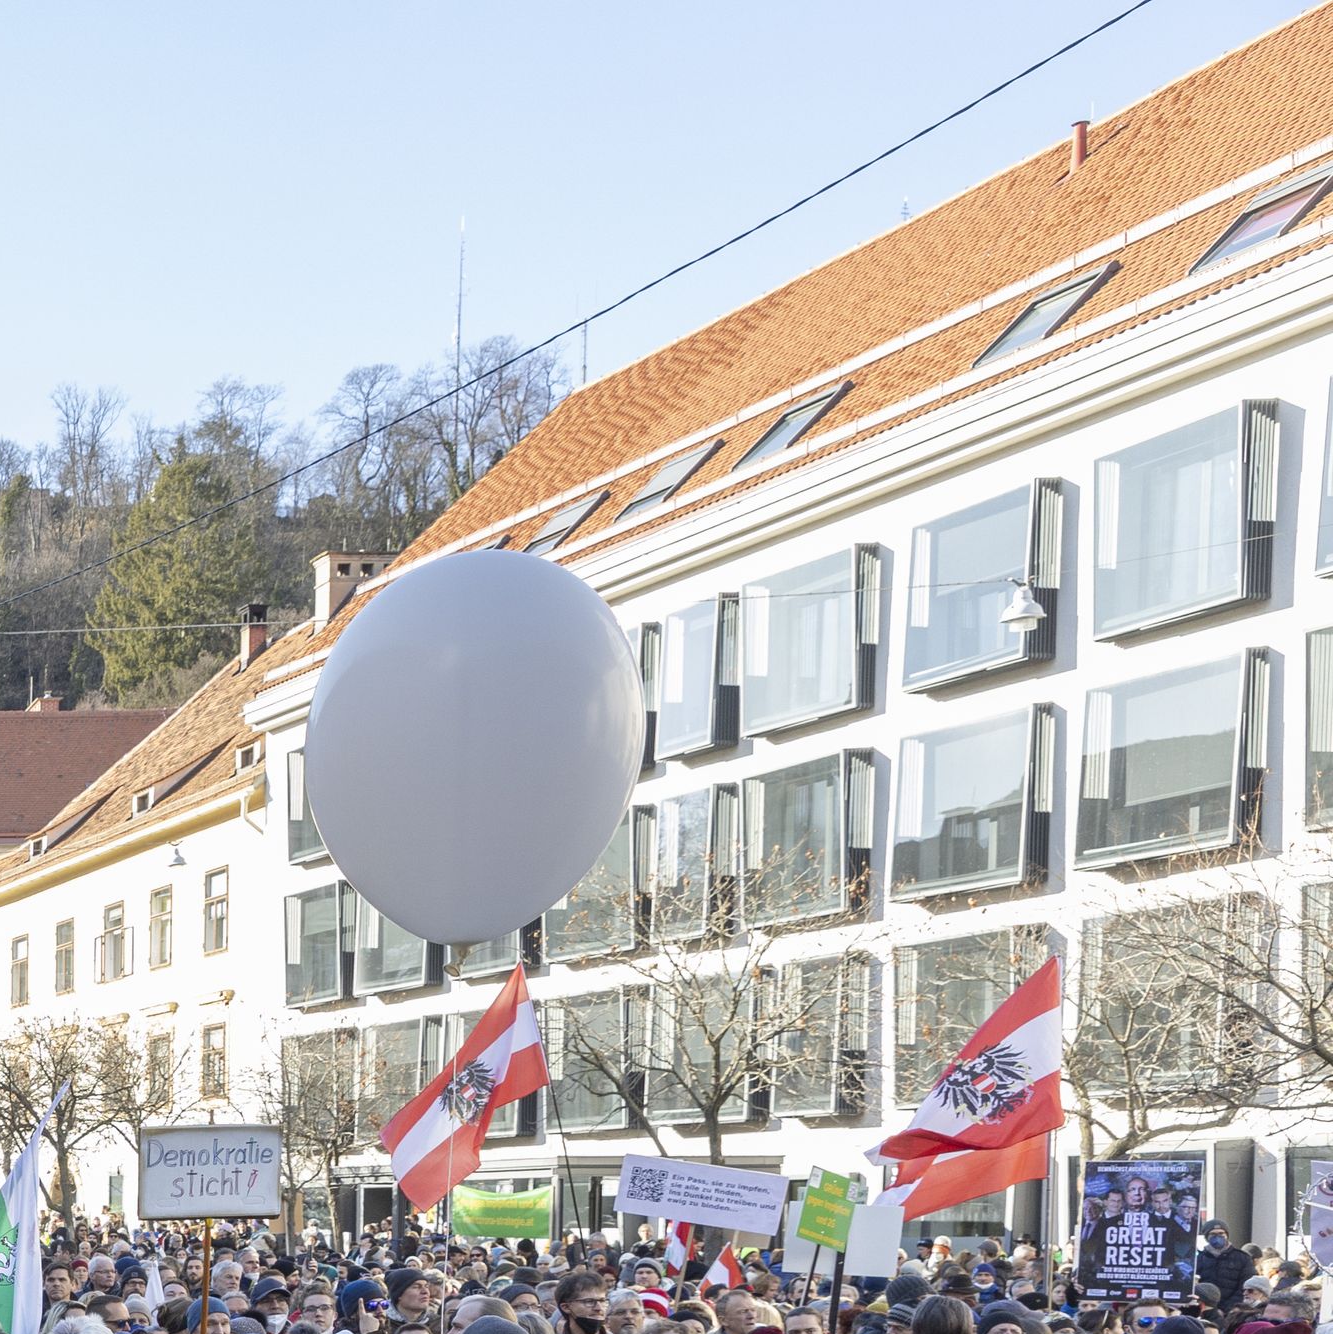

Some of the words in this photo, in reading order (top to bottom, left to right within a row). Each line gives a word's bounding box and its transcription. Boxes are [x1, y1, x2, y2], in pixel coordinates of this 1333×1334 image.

[147, 1137, 273, 1168] Demokratie
[685, 1184, 700, 1192] alle
[714, 1188, 743, 1198] finden,
[687, 1176, 709, 1186] Pass,
[738, 1183, 770, 1194] impfen,
[667, 1198, 686, 1206] ewig
[684, 1191, 713, 1201] Dunkel
[727, 1197, 758, 1208] treiben
[760, 1202, 777, 1210] und
[1124, 1213, 1149, 1225] DER
[1106, 1227, 1167, 1245] GREAT
[1105, 1247, 1166, 1266] RESET
